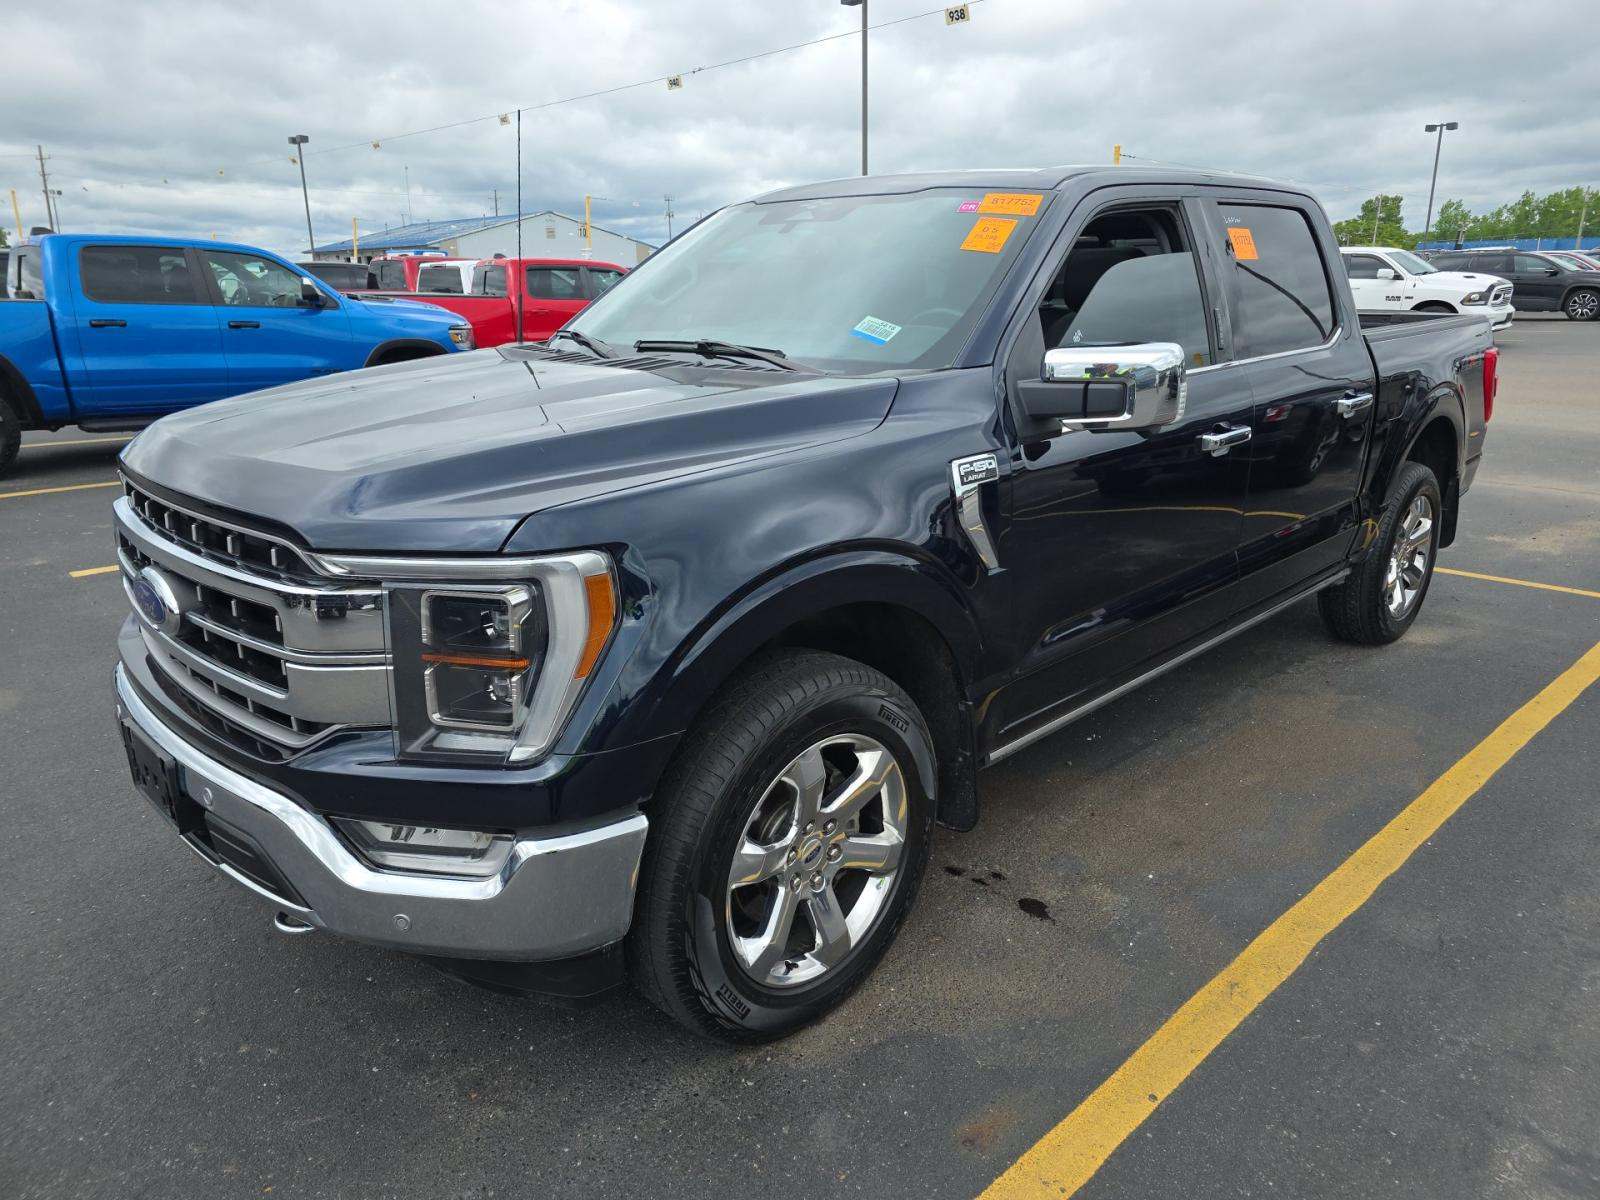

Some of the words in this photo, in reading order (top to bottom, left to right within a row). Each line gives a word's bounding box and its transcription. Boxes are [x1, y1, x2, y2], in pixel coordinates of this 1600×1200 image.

[948, 8, 966, 22] 938
[963, 472, 987, 483] LARIAT
[878, 704, 910, 734] PIRELLI
[715, 984, 751, 1021] PIRELLI
